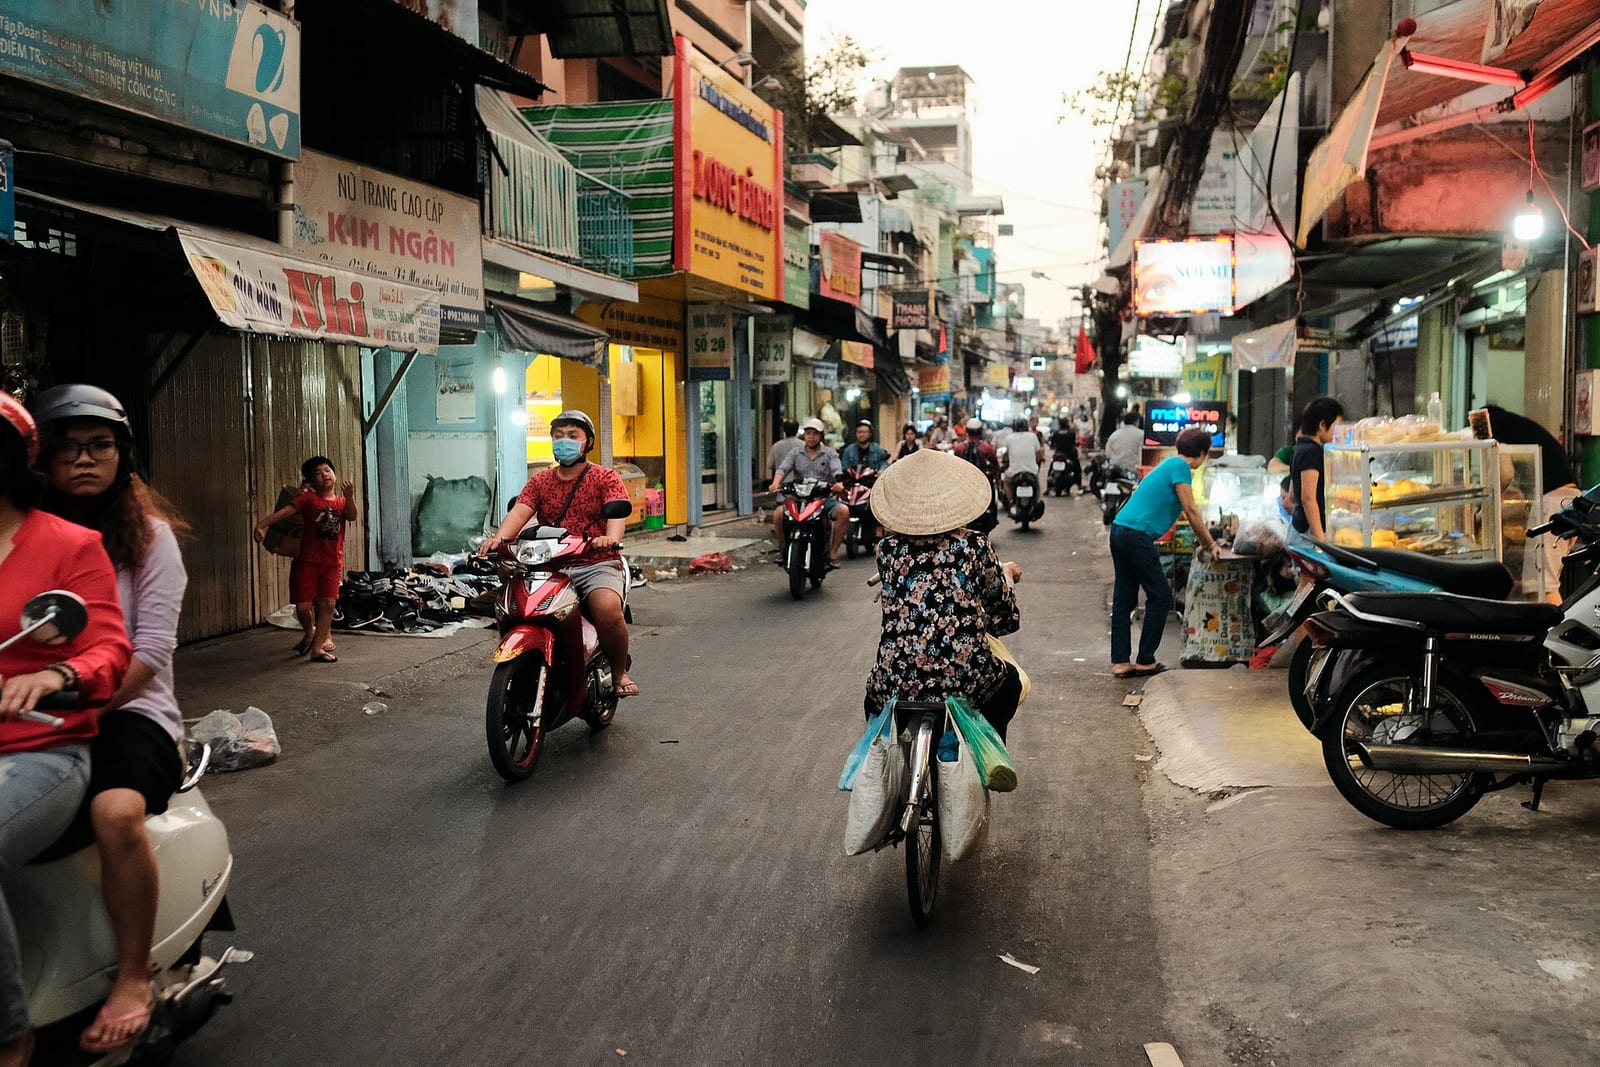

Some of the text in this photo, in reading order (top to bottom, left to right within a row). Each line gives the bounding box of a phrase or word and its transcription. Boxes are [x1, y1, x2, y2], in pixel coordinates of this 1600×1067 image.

[337, 171, 444, 224] NỮ TRANG CAO CẤP
[692, 149, 737, 214] LONG
[327, 211, 456, 267] KIM NGÂN
[694, 331, 708, 353] SỐ
[710, 336, 726, 353] 20
[773, 343, 786, 361] 20
[1469, 633, 1501, 641] HONDA
